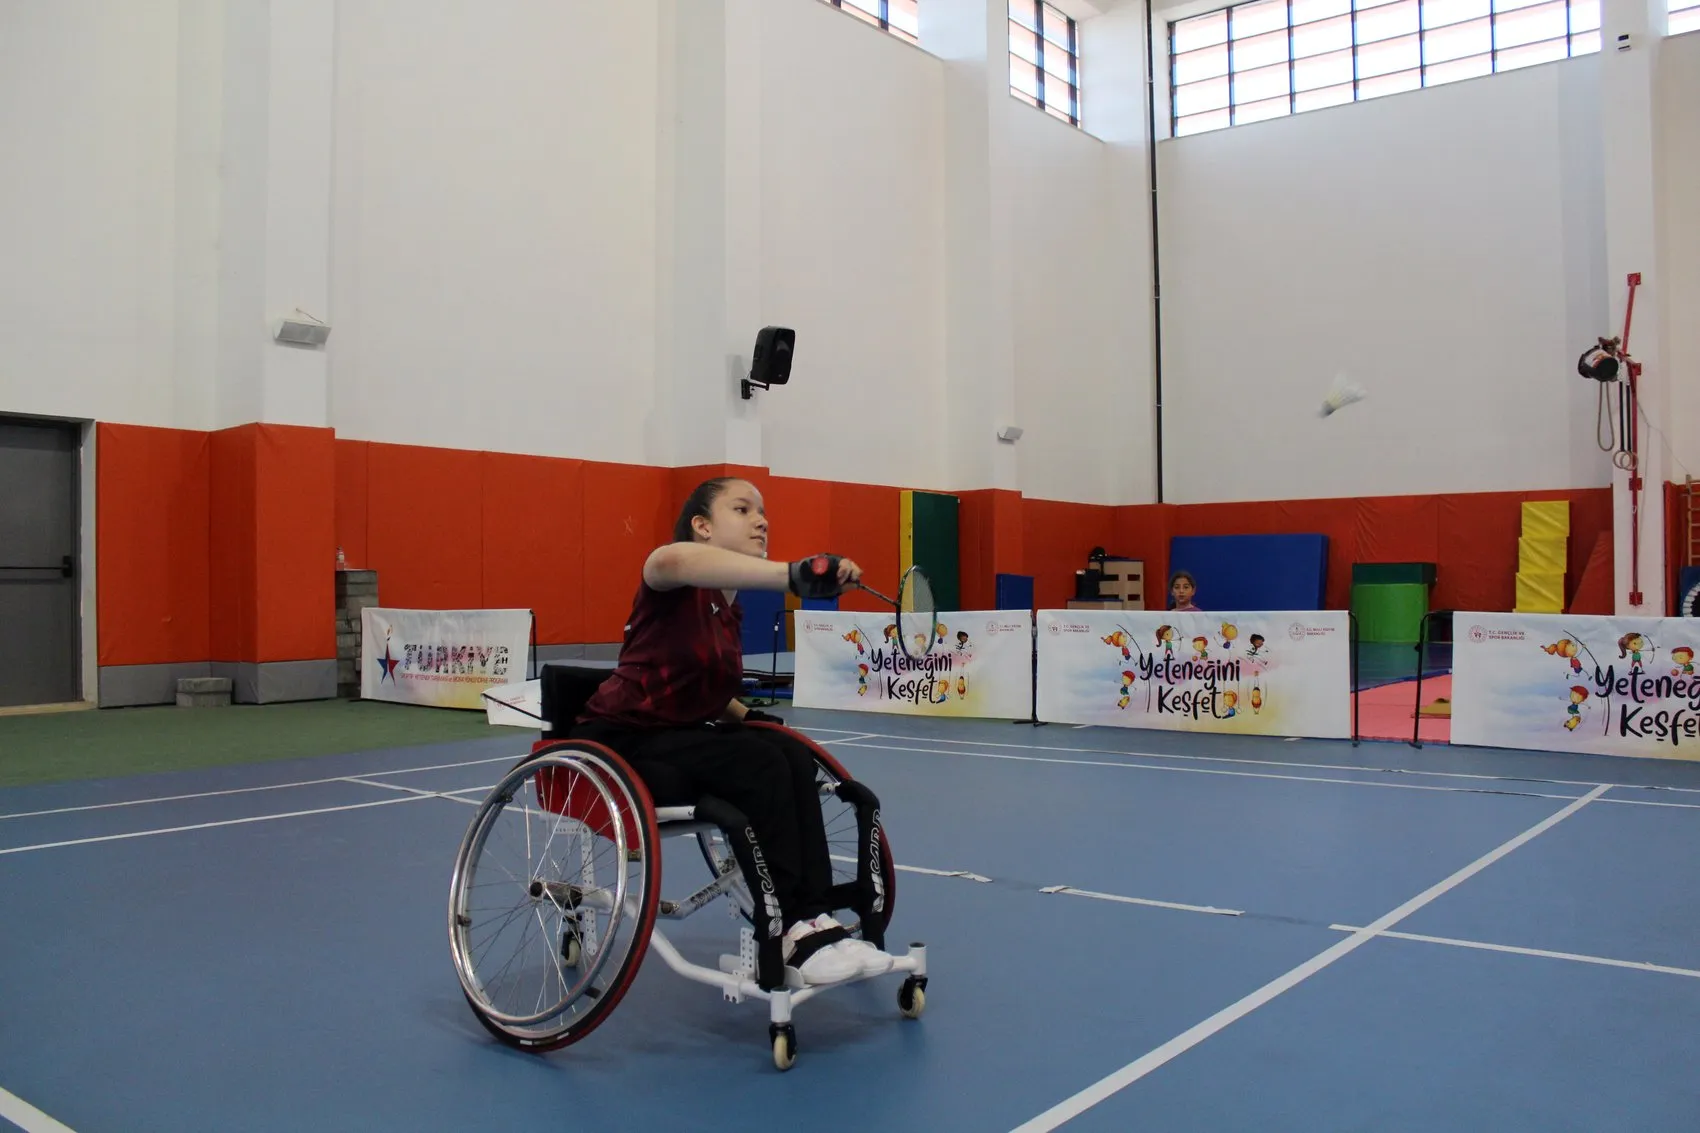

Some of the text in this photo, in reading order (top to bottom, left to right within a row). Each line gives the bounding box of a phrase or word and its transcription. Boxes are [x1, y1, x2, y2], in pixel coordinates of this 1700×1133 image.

[871, 647, 952, 679] Yeteneğini
[1140, 652, 1240, 690] Yeteneğini
[887, 676, 938, 705] Keşfet
[1158, 685, 1222, 720] Keşfet
[1620, 704, 1700, 746] Keşfe
